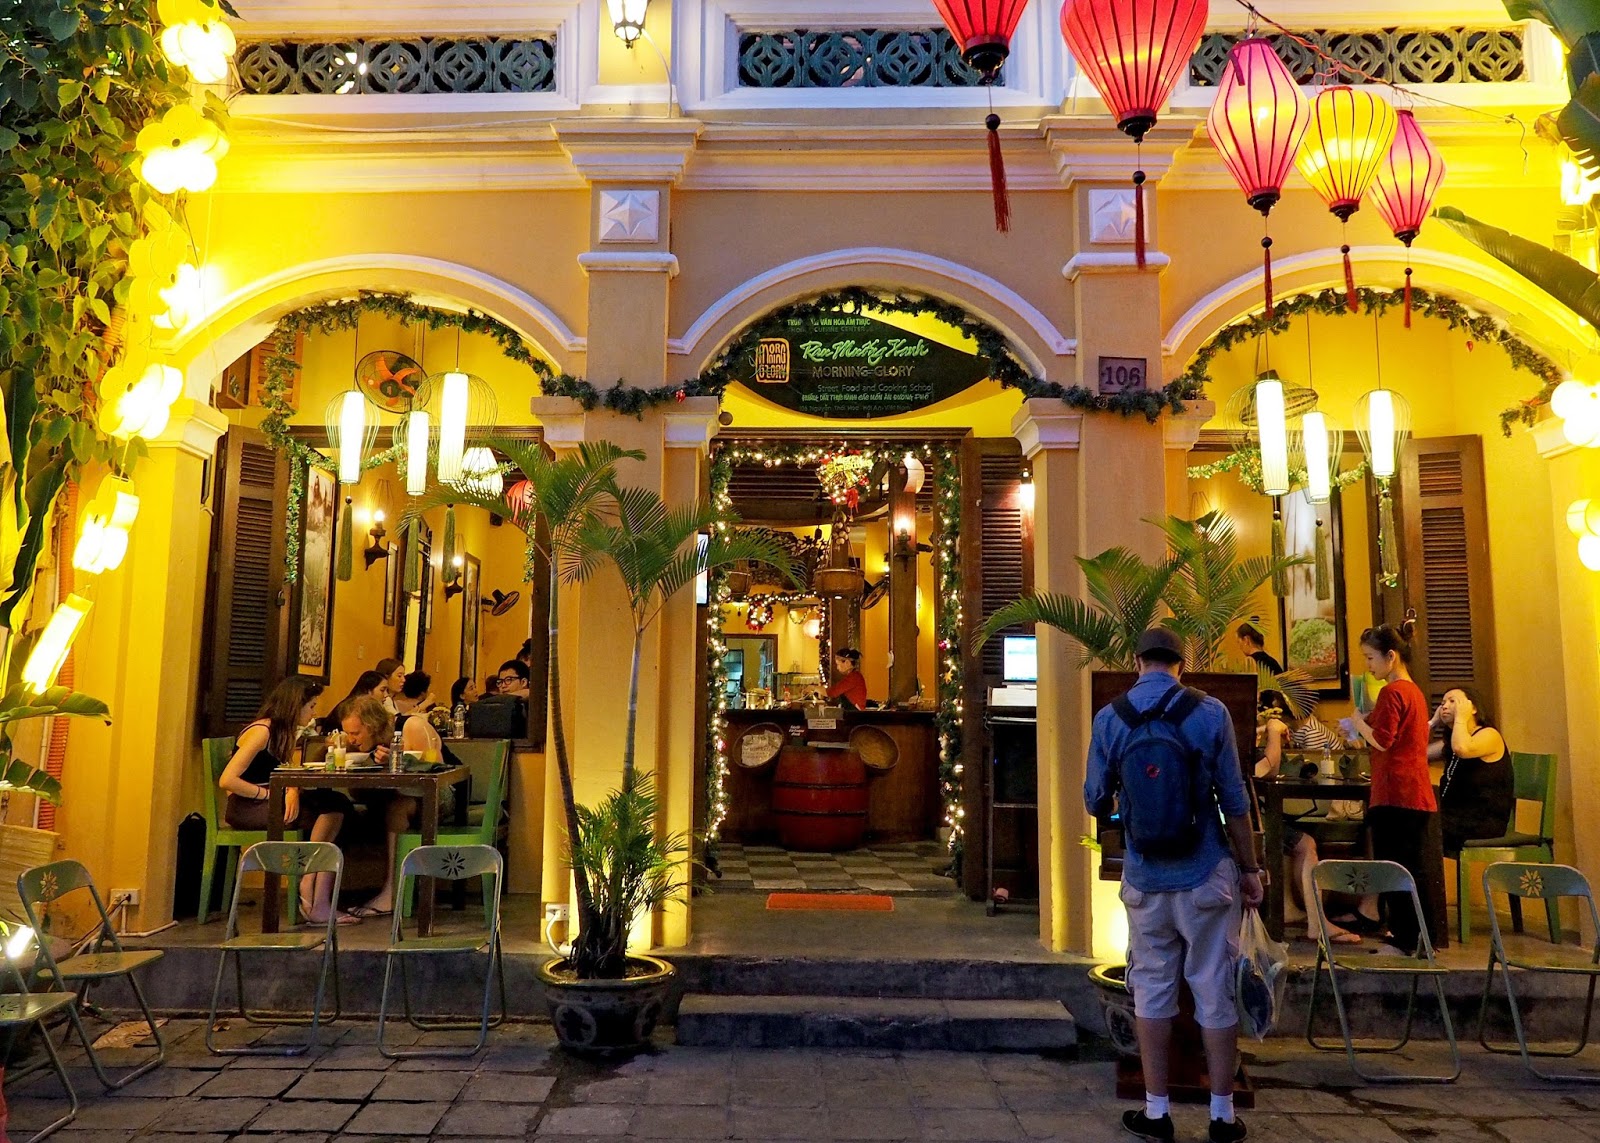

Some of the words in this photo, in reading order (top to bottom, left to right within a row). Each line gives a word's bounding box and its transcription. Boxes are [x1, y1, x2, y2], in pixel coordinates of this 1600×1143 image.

[812, 365, 868, 379] MORNING
[874, 365, 913, 378] GLORY
[1105, 366, 1141, 386] 106
[817, 384, 839, 392] Street
[842, 383, 860, 392] Food
[862, 383, 877, 392] and
[878, 383, 908, 393] Cooking
[910, 383, 934, 392] School
